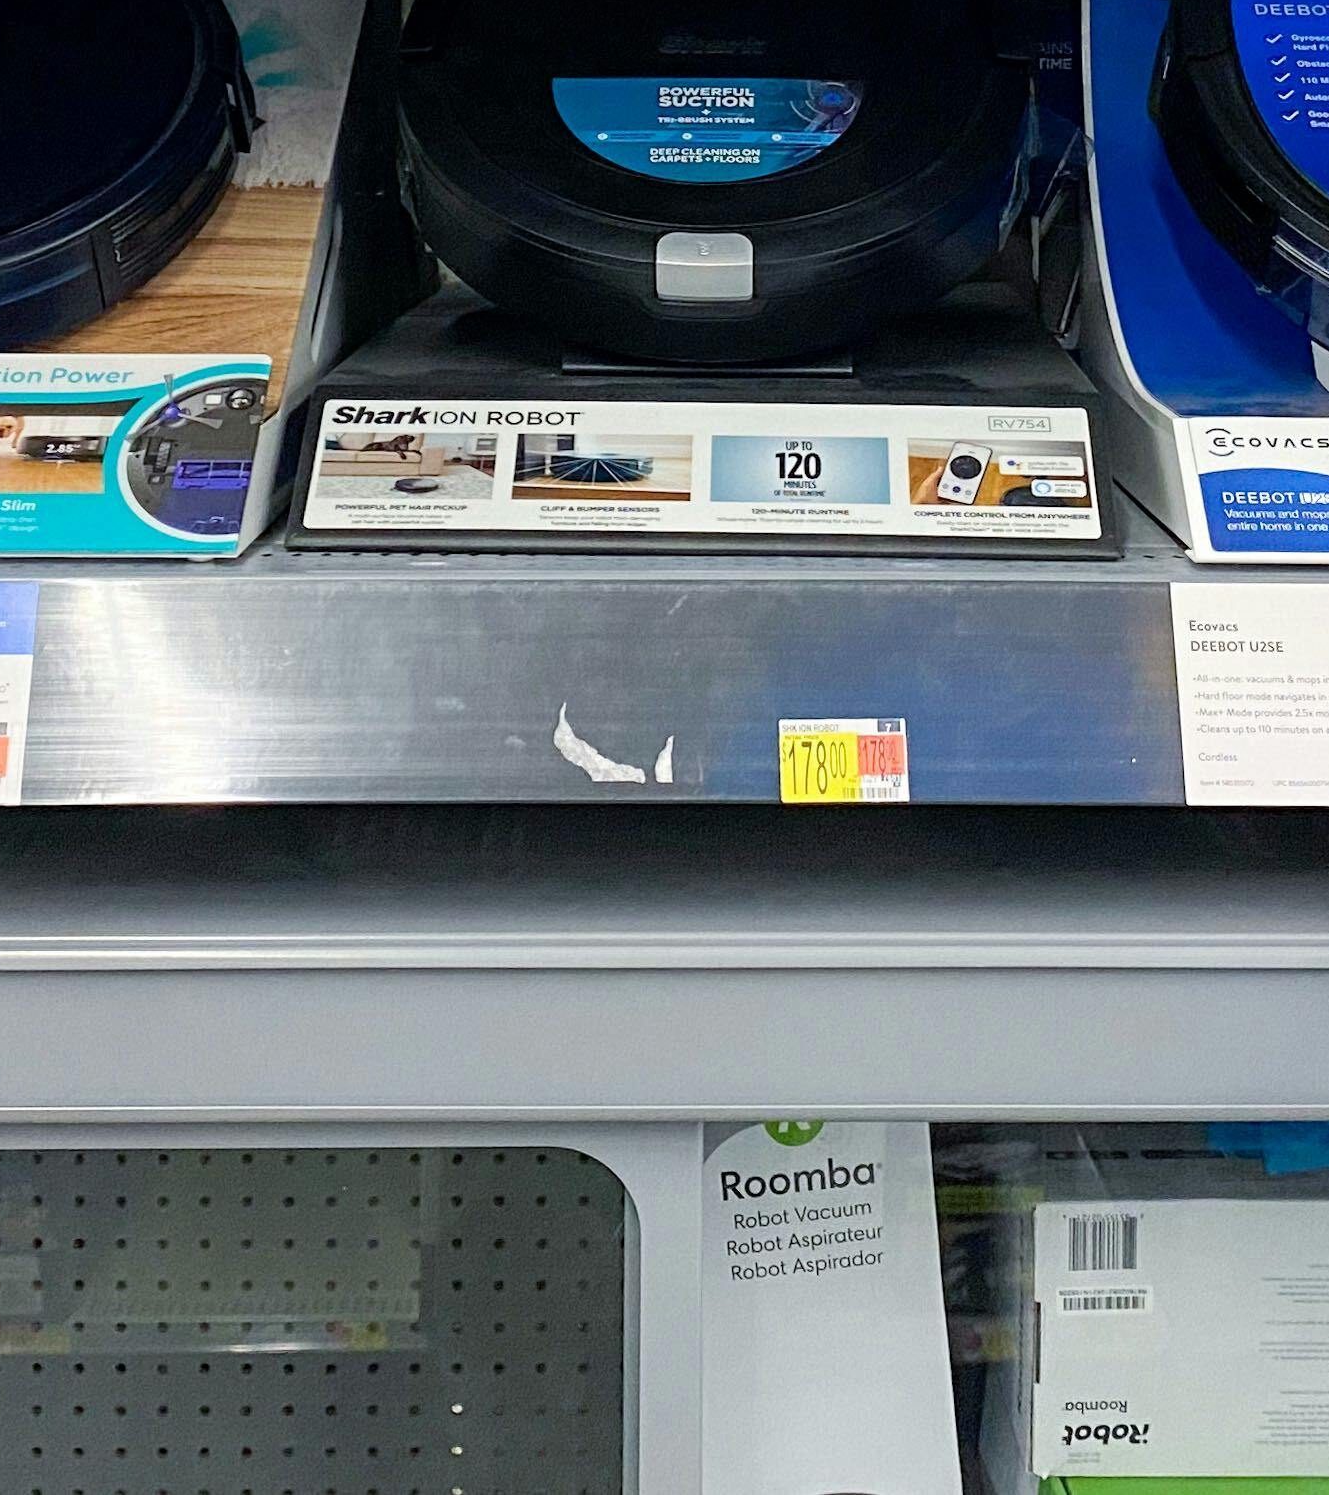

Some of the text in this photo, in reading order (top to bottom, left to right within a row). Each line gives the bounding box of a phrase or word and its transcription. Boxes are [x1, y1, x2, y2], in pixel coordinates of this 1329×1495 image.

[659, 86, 754, 96] POWERFUL
[659, 96, 754, 108] SUCTION
[50, 368, 133, 383] Power
[332, 406, 432, 424] Shark
[487, 411, 581, 426] ROBOT
[993, 418, 1046, 430] RV754
[786, 442, 812, 450] UP TO
[776, 453, 821, 479] 120
[784, 480, 816, 490] MINUTES
[1223, 491, 1294, 505] DEEBOT
[0, 500, 35, 510] Slim
[1189, 620, 1238, 631] Ecovacs
[1191, 641, 1283, 652] DEEBOT U2SE
[721, 1157, 874, 1201] Roomba
[734, 1203, 871, 1230] Robot Vacuum
[727, 1227, 880, 1256] Robot Aspirateur
[732, 1251, 882, 1280] Robot Aspirador
[1066, 1401, 1127, 1414] Roomba
